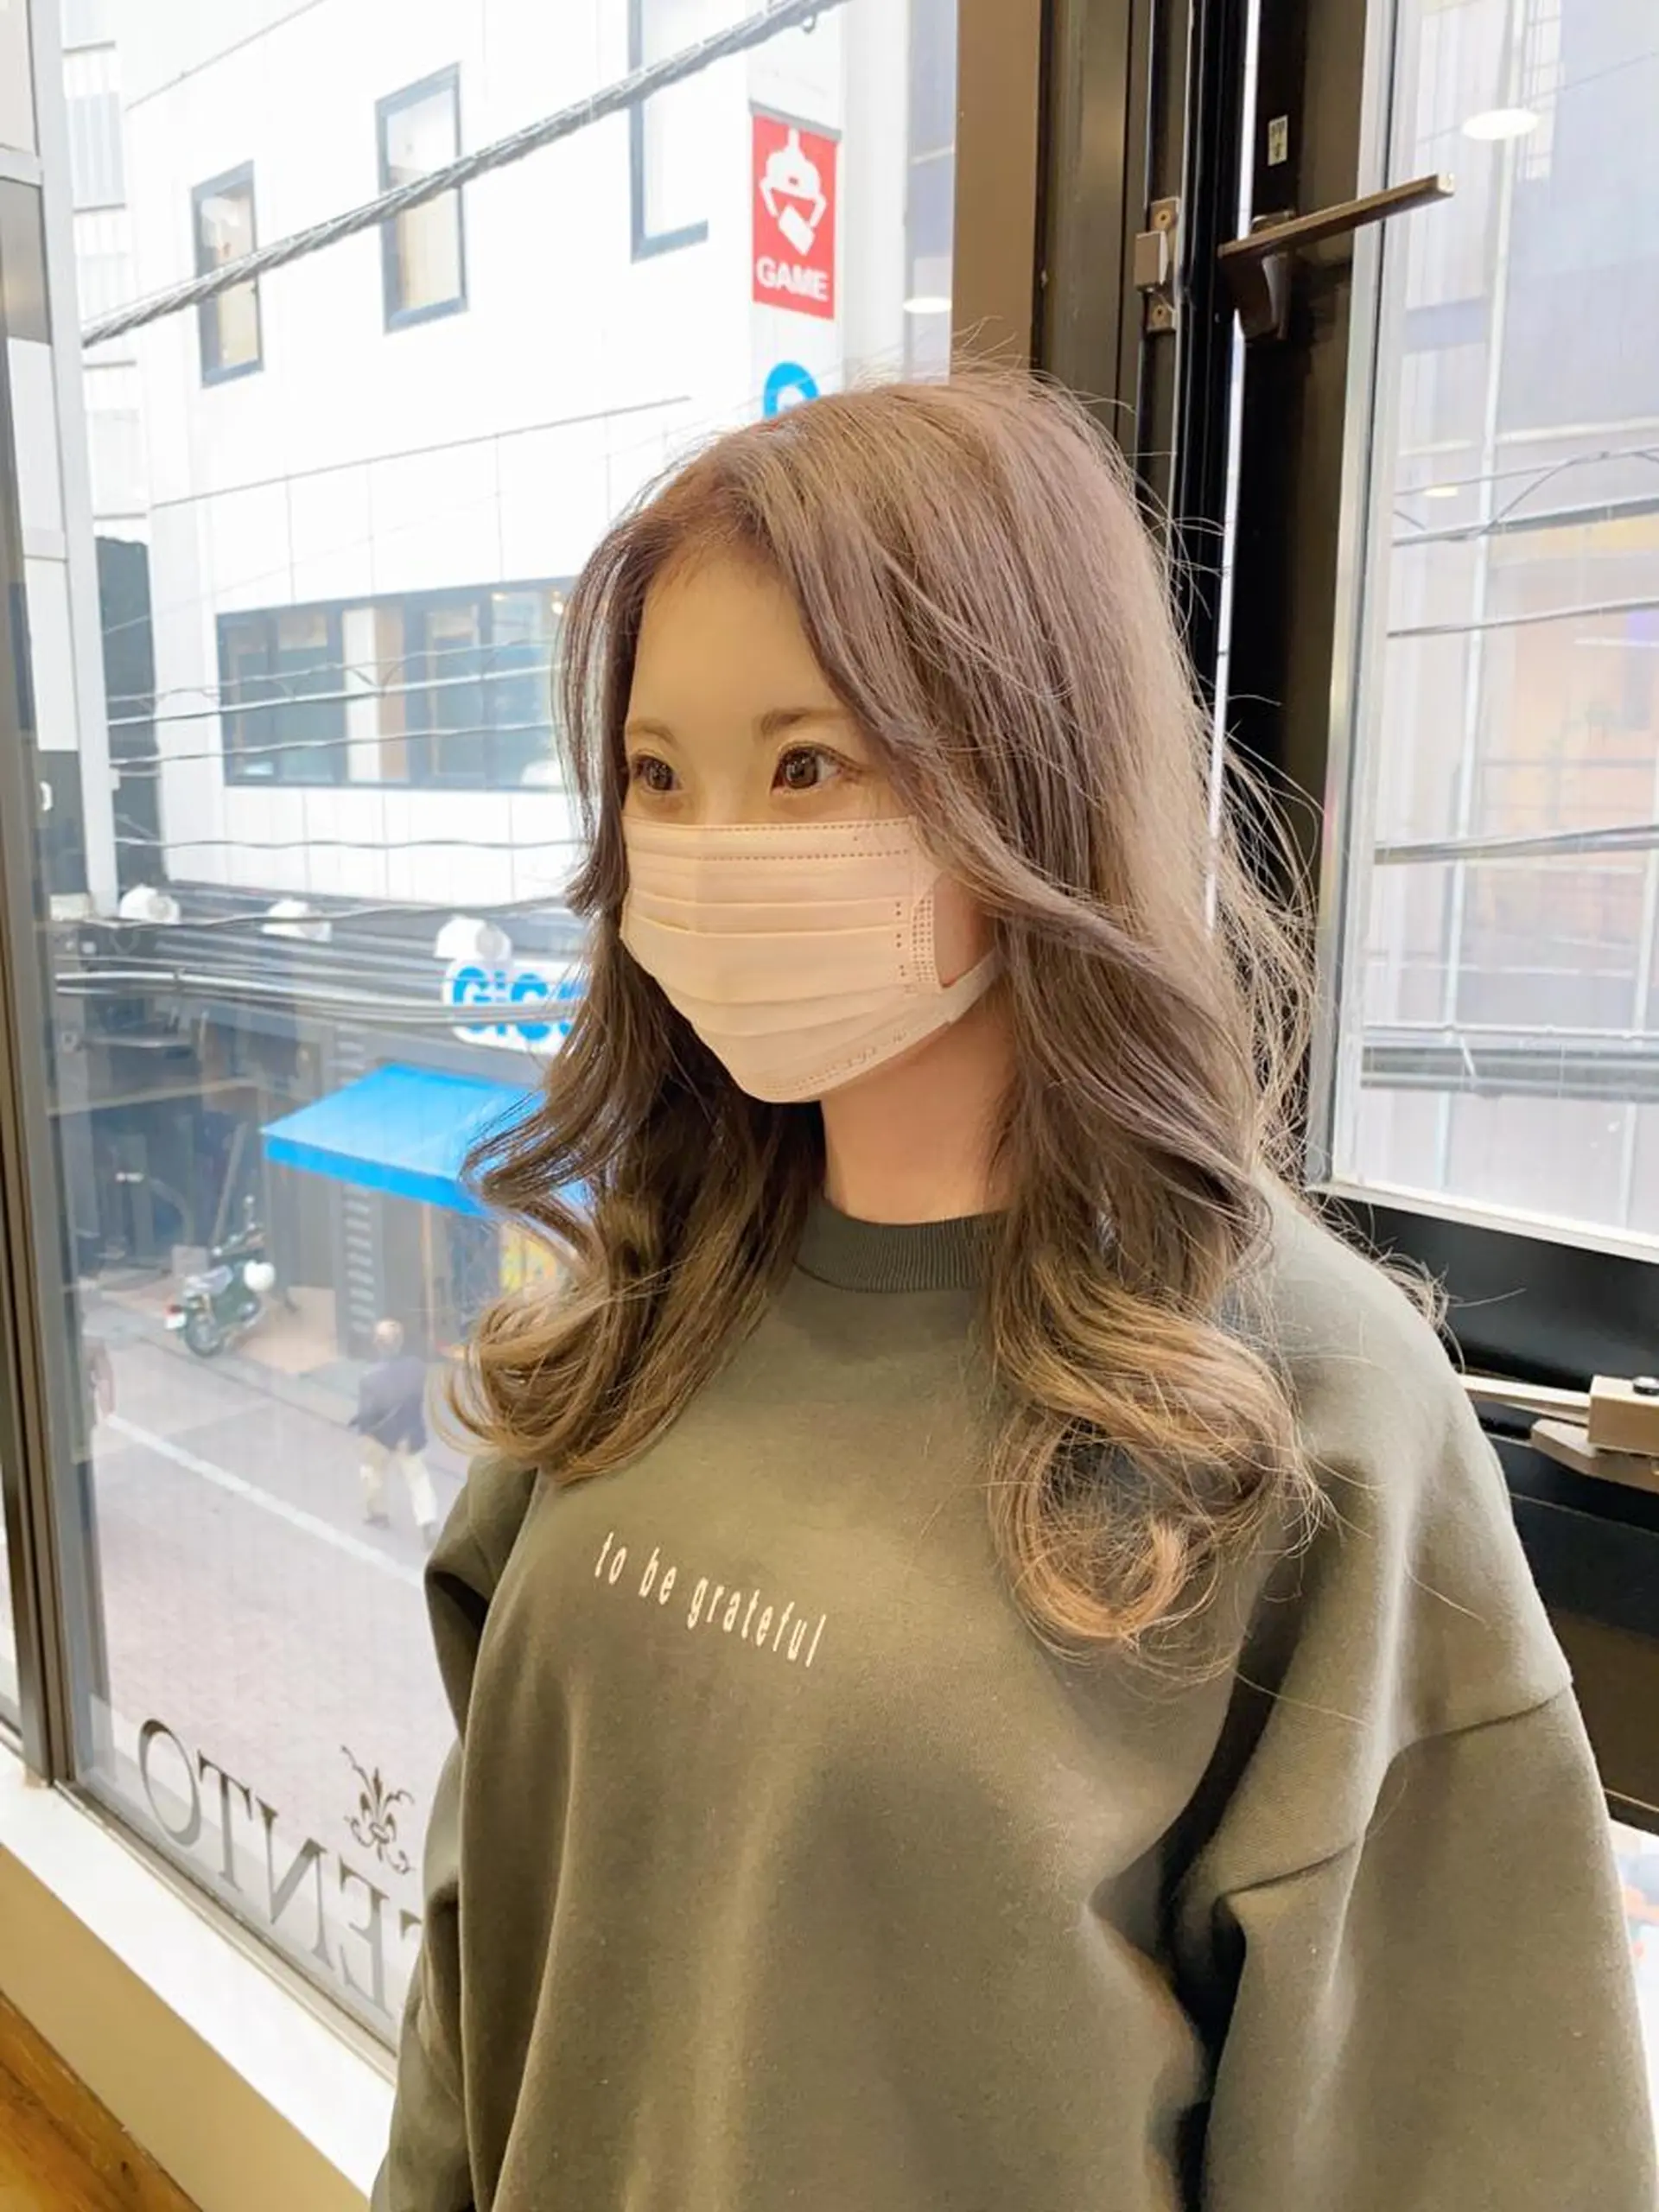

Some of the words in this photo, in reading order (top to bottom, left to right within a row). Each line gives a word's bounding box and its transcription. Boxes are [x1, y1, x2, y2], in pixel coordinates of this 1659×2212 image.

[756, 257, 829, 302] GAME
[594, 1531, 627, 1585] to
[639, 1547, 677, 1605] be
[687, 1577, 827, 1668] grateful
